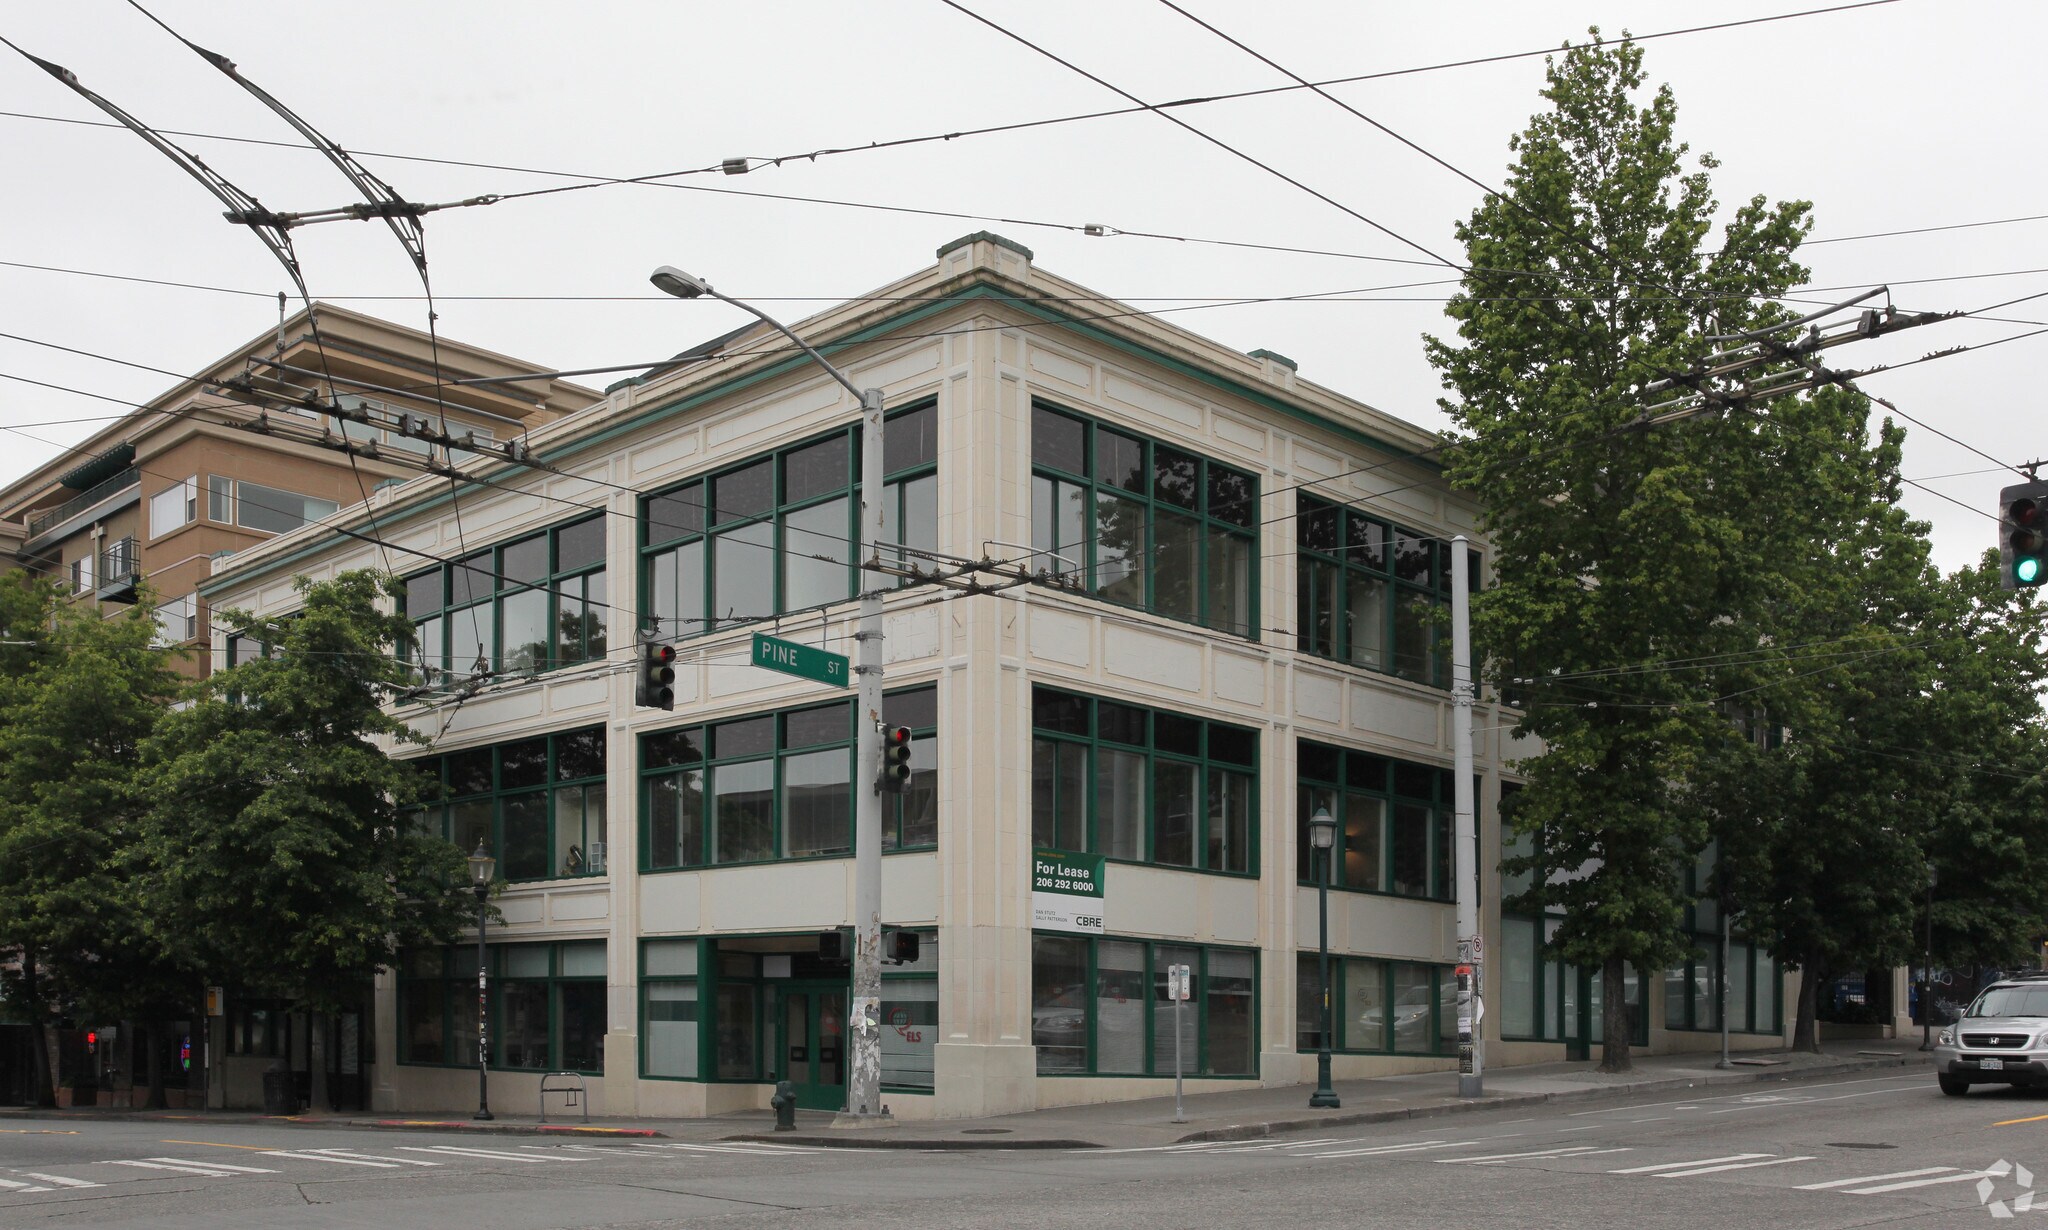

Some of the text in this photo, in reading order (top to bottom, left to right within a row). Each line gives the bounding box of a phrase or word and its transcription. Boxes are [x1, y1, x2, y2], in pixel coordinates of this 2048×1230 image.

[763, 642, 840, 675] PINE ST
[1037, 861, 1090, 878] For Lease
[1036, 878, 1094, 892] 206 292 6000
[1076, 917, 1102, 927] CBRE
[906, 1032, 922, 1042] ELS
